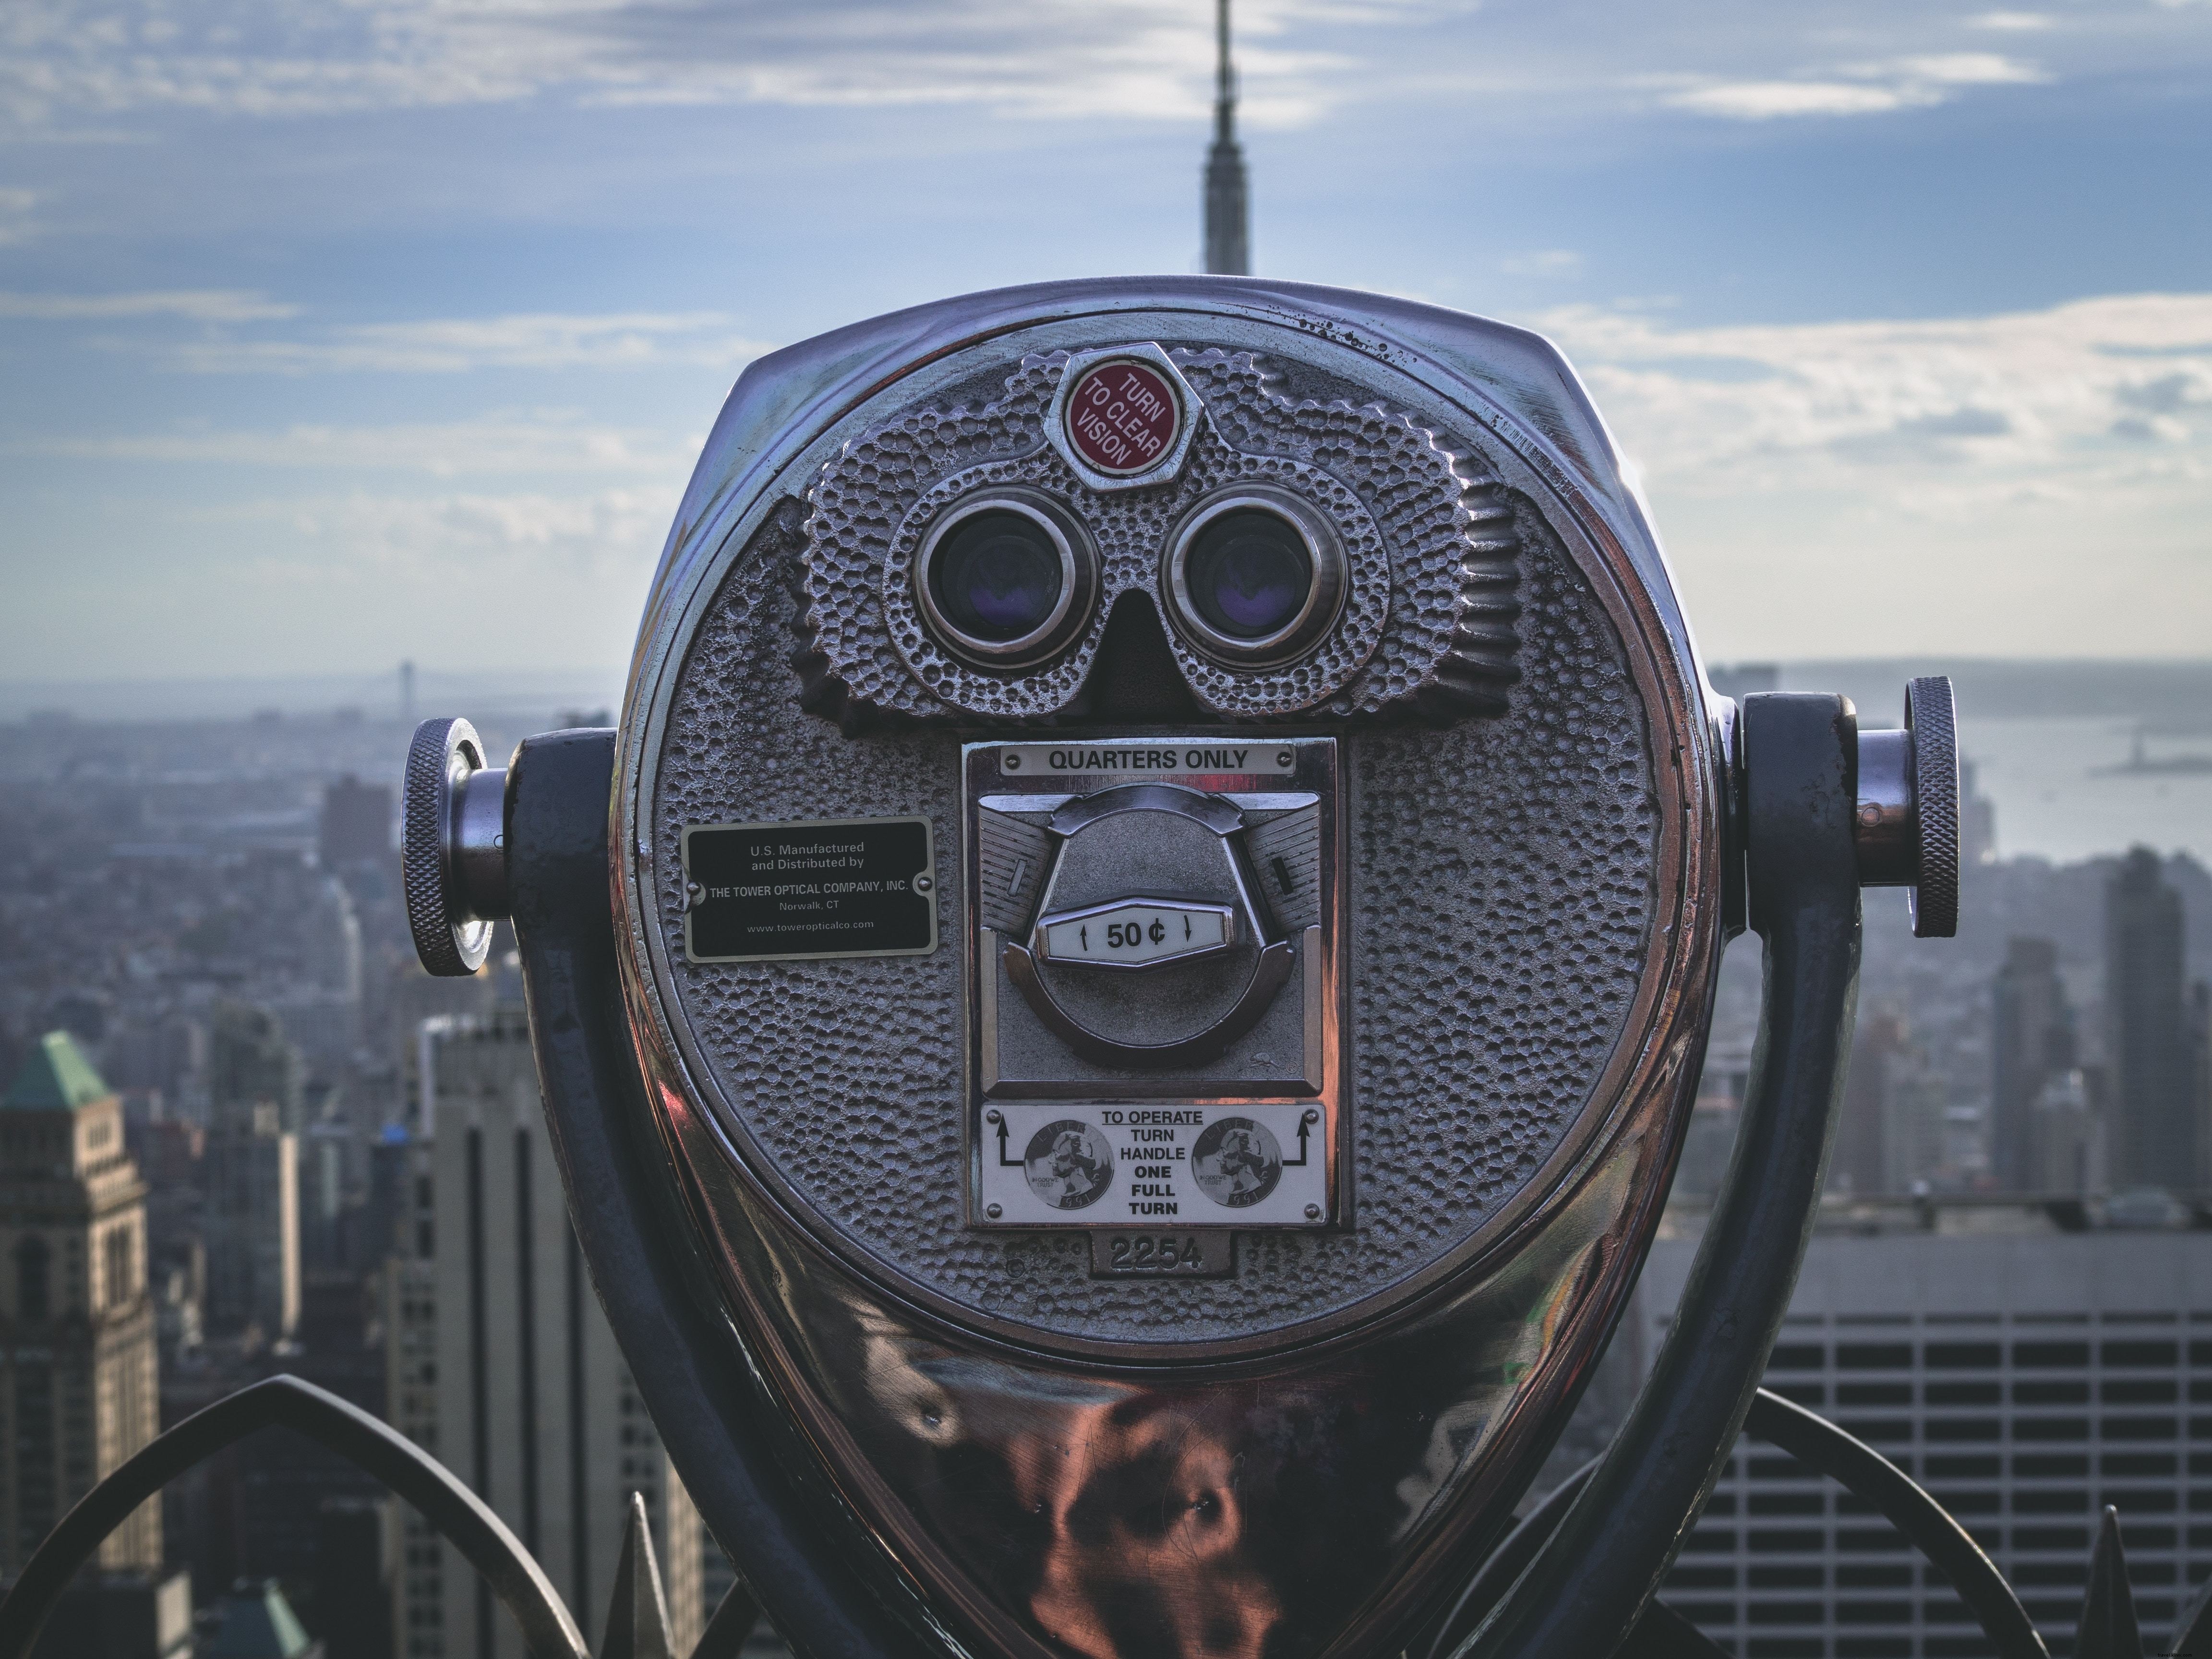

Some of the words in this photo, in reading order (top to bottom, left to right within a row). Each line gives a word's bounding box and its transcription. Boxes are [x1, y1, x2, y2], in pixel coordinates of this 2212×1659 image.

[1119, 373, 1166, 422] TURN
[1085, 377, 1110, 406] TO
[1106, 401, 1161, 457] CLEAR
[1077, 407, 1132, 465] VISION
[1049, 750, 1177, 769] QUARTERS
[1185, 750, 1248, 769] ONLY
[751, 845, 775, 856] U.S.
[779, 842, 864, 855] Manufactured
[752, 860, 774, 870] and
[778, 856, 845, 869] Distributed
[849, 856, 864, 868] by
[710, 887, 730, 898] THE
[733, 886, 771, 897] TOWER
[774, 884, 820, 895] OPTICAL
[823, 881, 883, 893] COMPANY,
[887, 880, 908, 890] INC.
[780, 901, 823, 911] Norwalk,
[827, 901, 840, 909] CT
[747, 921, 874, 933] www.toweropticalco.com
[1102, 1111, 1123, 1124] TO
[1129, 1111, 1203, 1124] OPERATE
[1131, 1130, 1174, 1142] TURN
[1121, 1148, 1185, 1160] HANDLE
[1134, 1166, 1171, 1178] ONE
[1131, 1184, 1176, 1196] FULL
[1129, 1202, 1178, 1214] TURN
[1110, 1236, 1202, 1270] 2254
